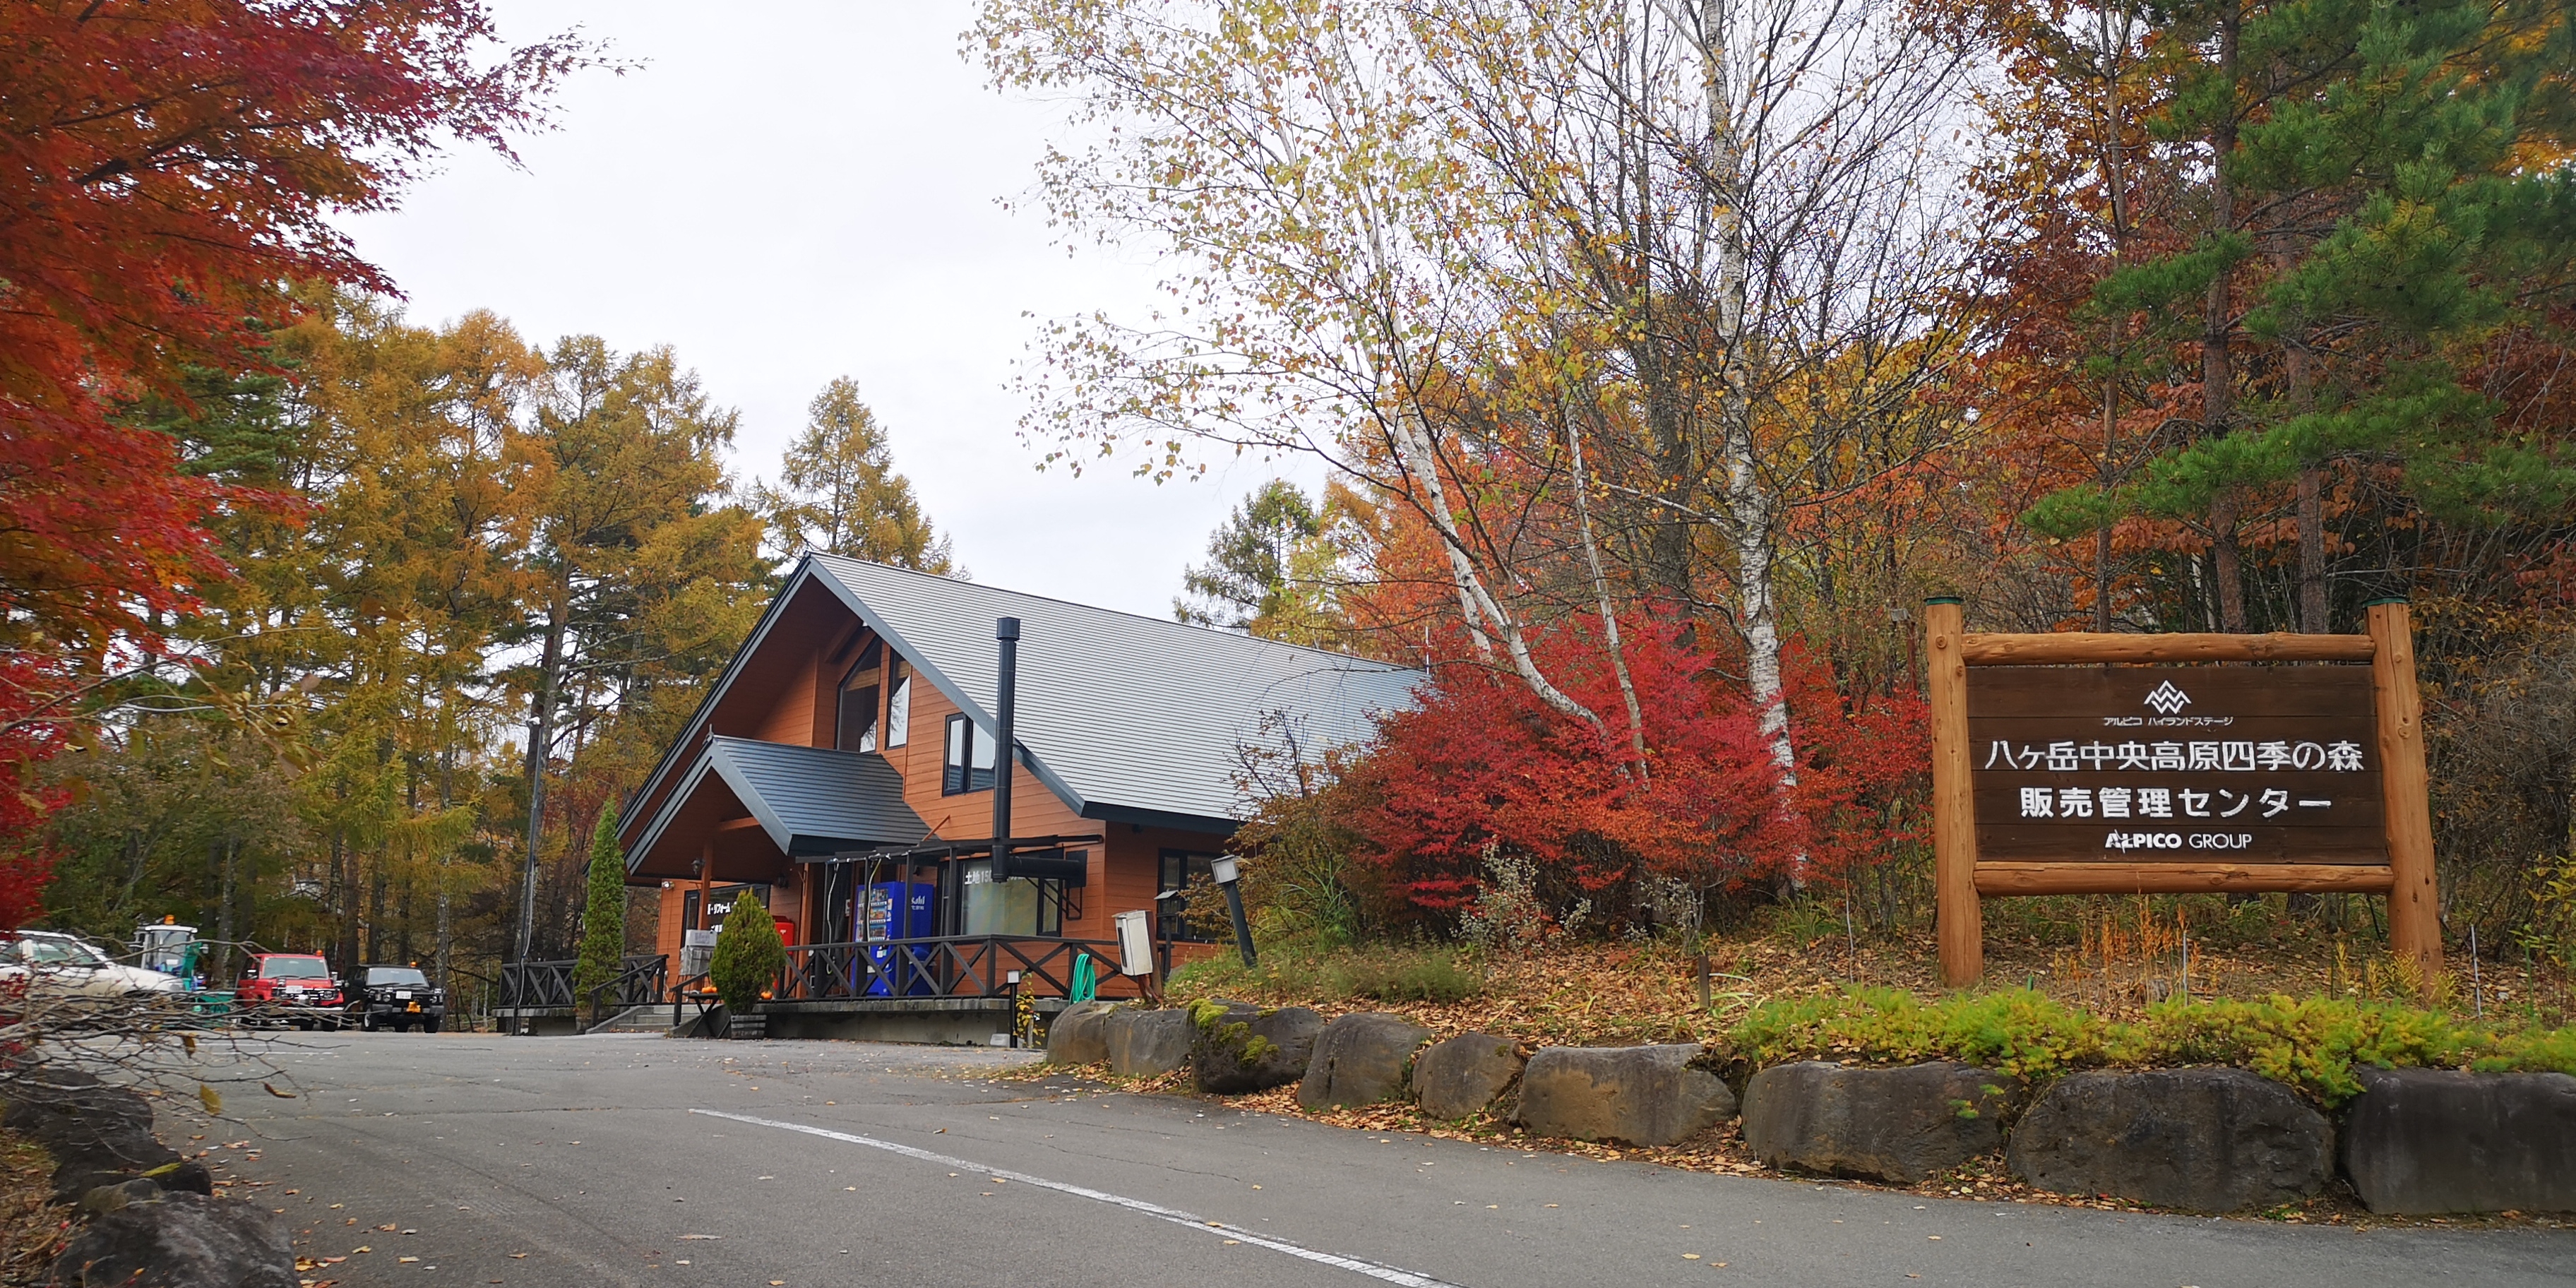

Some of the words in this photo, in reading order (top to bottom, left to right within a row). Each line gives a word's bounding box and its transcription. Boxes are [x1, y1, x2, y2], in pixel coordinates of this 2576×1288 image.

[2103, 717, 2142, 727] アルピコ
[2147, 717, 2234, 727] ハイランドステージ
[1985, 740, 2365, 772] 八ヶ岳中央高原四季の森
[2020, 787, 2332, 818] 販売管理センター
[2105, 830, 2182, 853] ALPICO
[2188, 833, 2253, 849] GROUP
